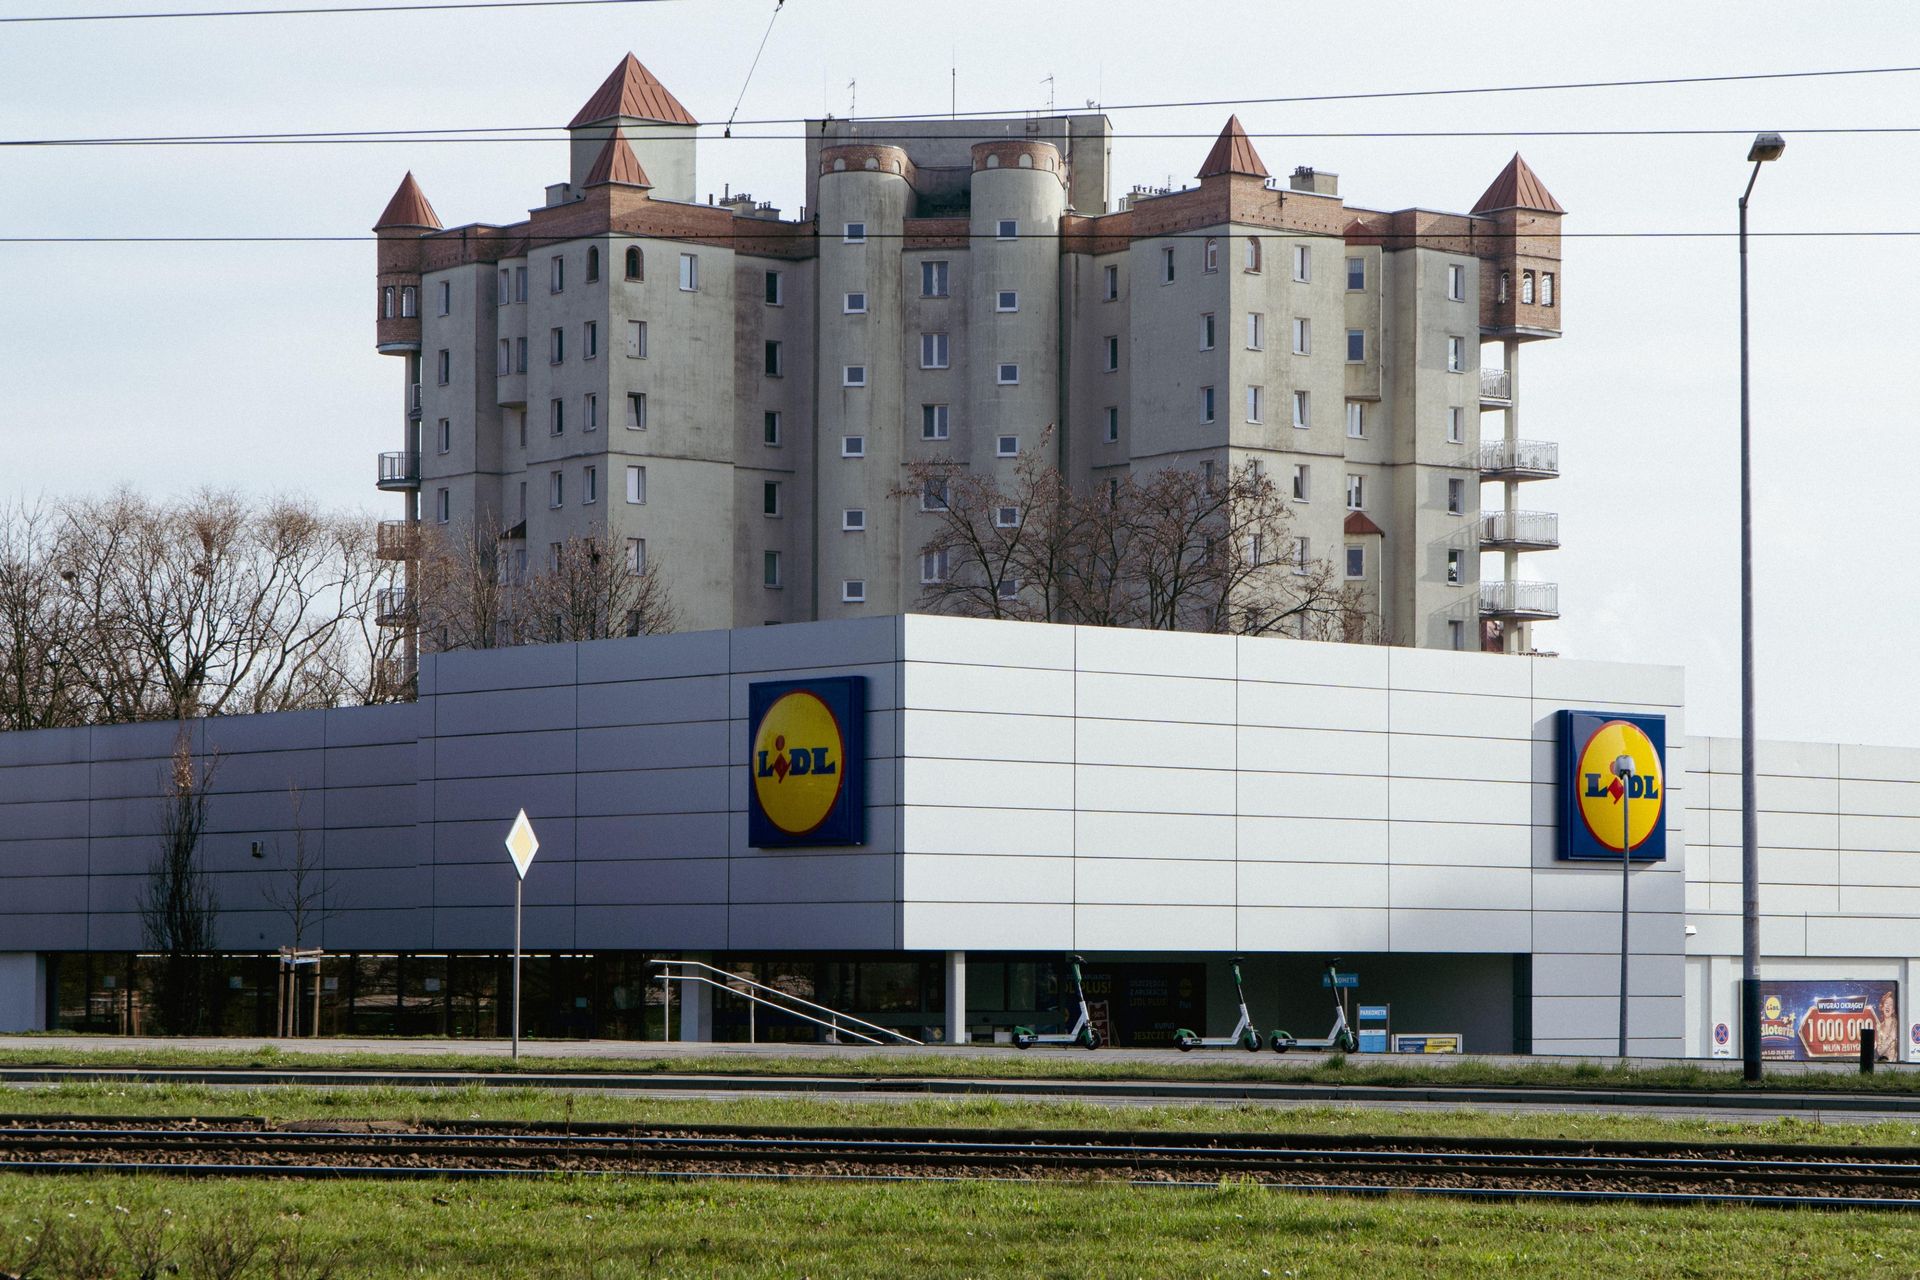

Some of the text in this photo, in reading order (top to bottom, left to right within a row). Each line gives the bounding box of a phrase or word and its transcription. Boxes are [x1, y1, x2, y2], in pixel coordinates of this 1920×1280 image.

[1323, 976, 1357, 984] PAOMETR
[1761, 1023, 1795, 1038] dloteria
[1808, 1018, 1814, 1042] 1
[1817, 1018, 1844, 1041] 000
[1841, 1044, 1861, 1052] ZŁOTYC
